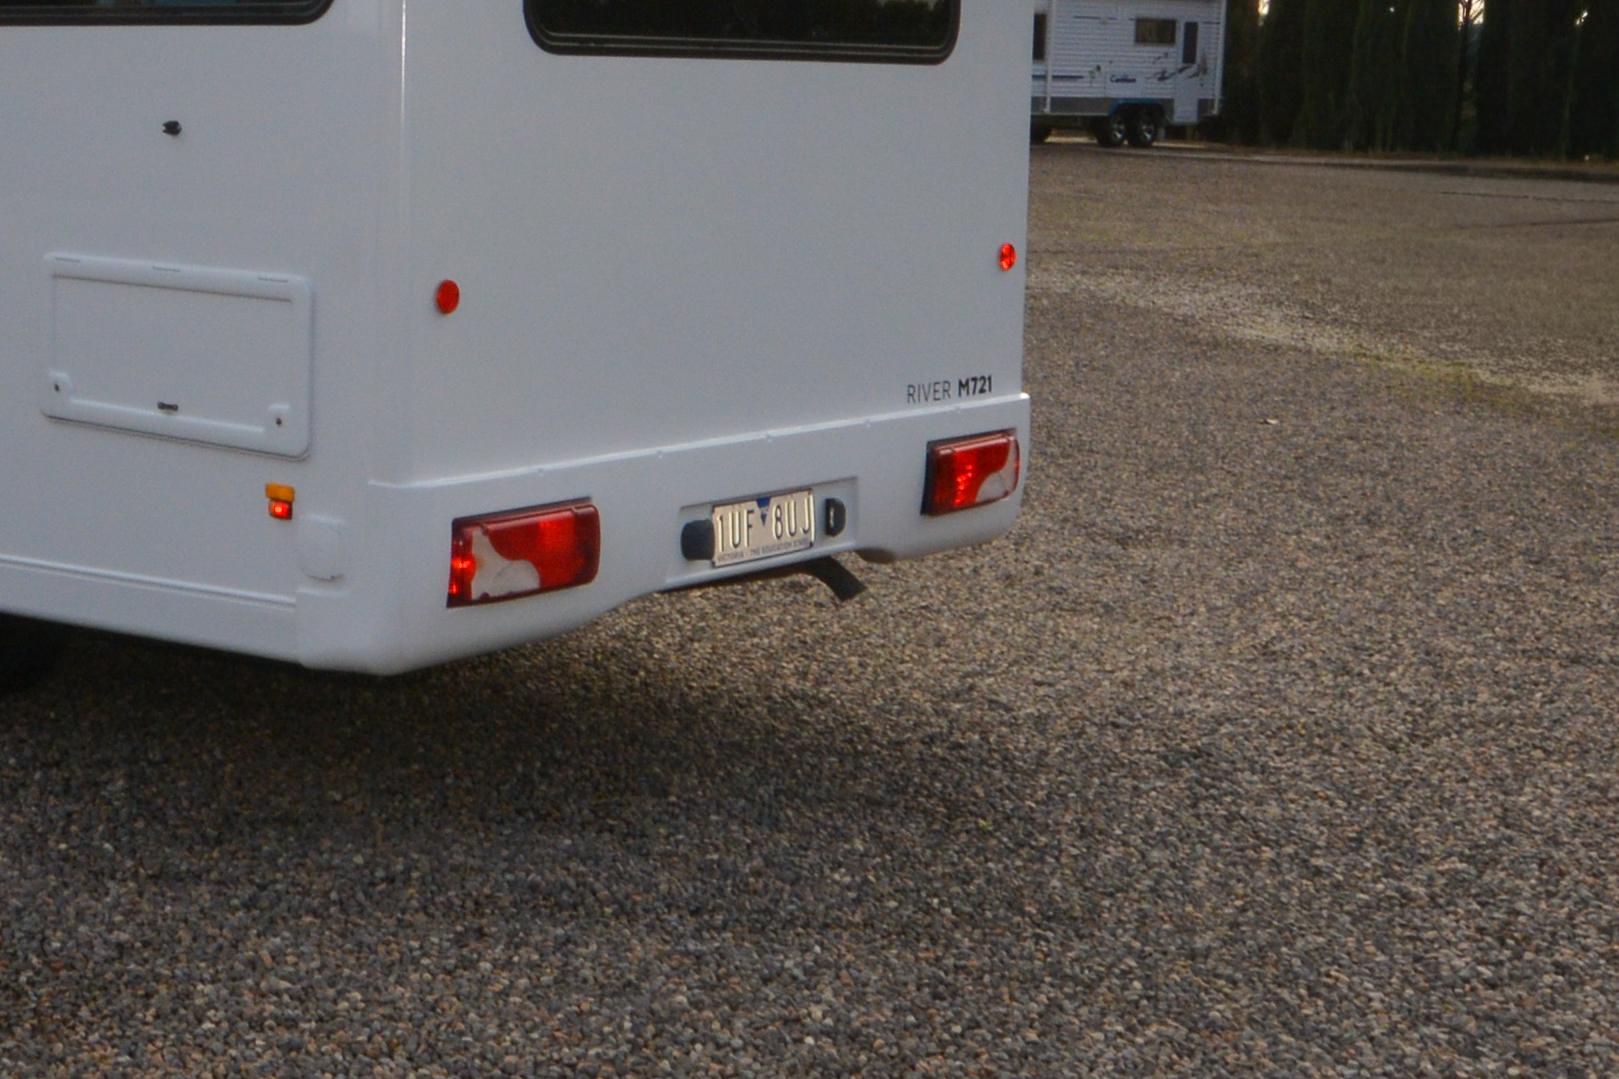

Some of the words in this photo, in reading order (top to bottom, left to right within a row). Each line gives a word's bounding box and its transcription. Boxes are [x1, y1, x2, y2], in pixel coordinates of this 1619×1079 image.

[907, 380, 951, 404] RIVER
[958, 375, 992, 397] M721
[717, 509, 754, 553] 1UF
[771, 497, 811, 539] 8UJ
